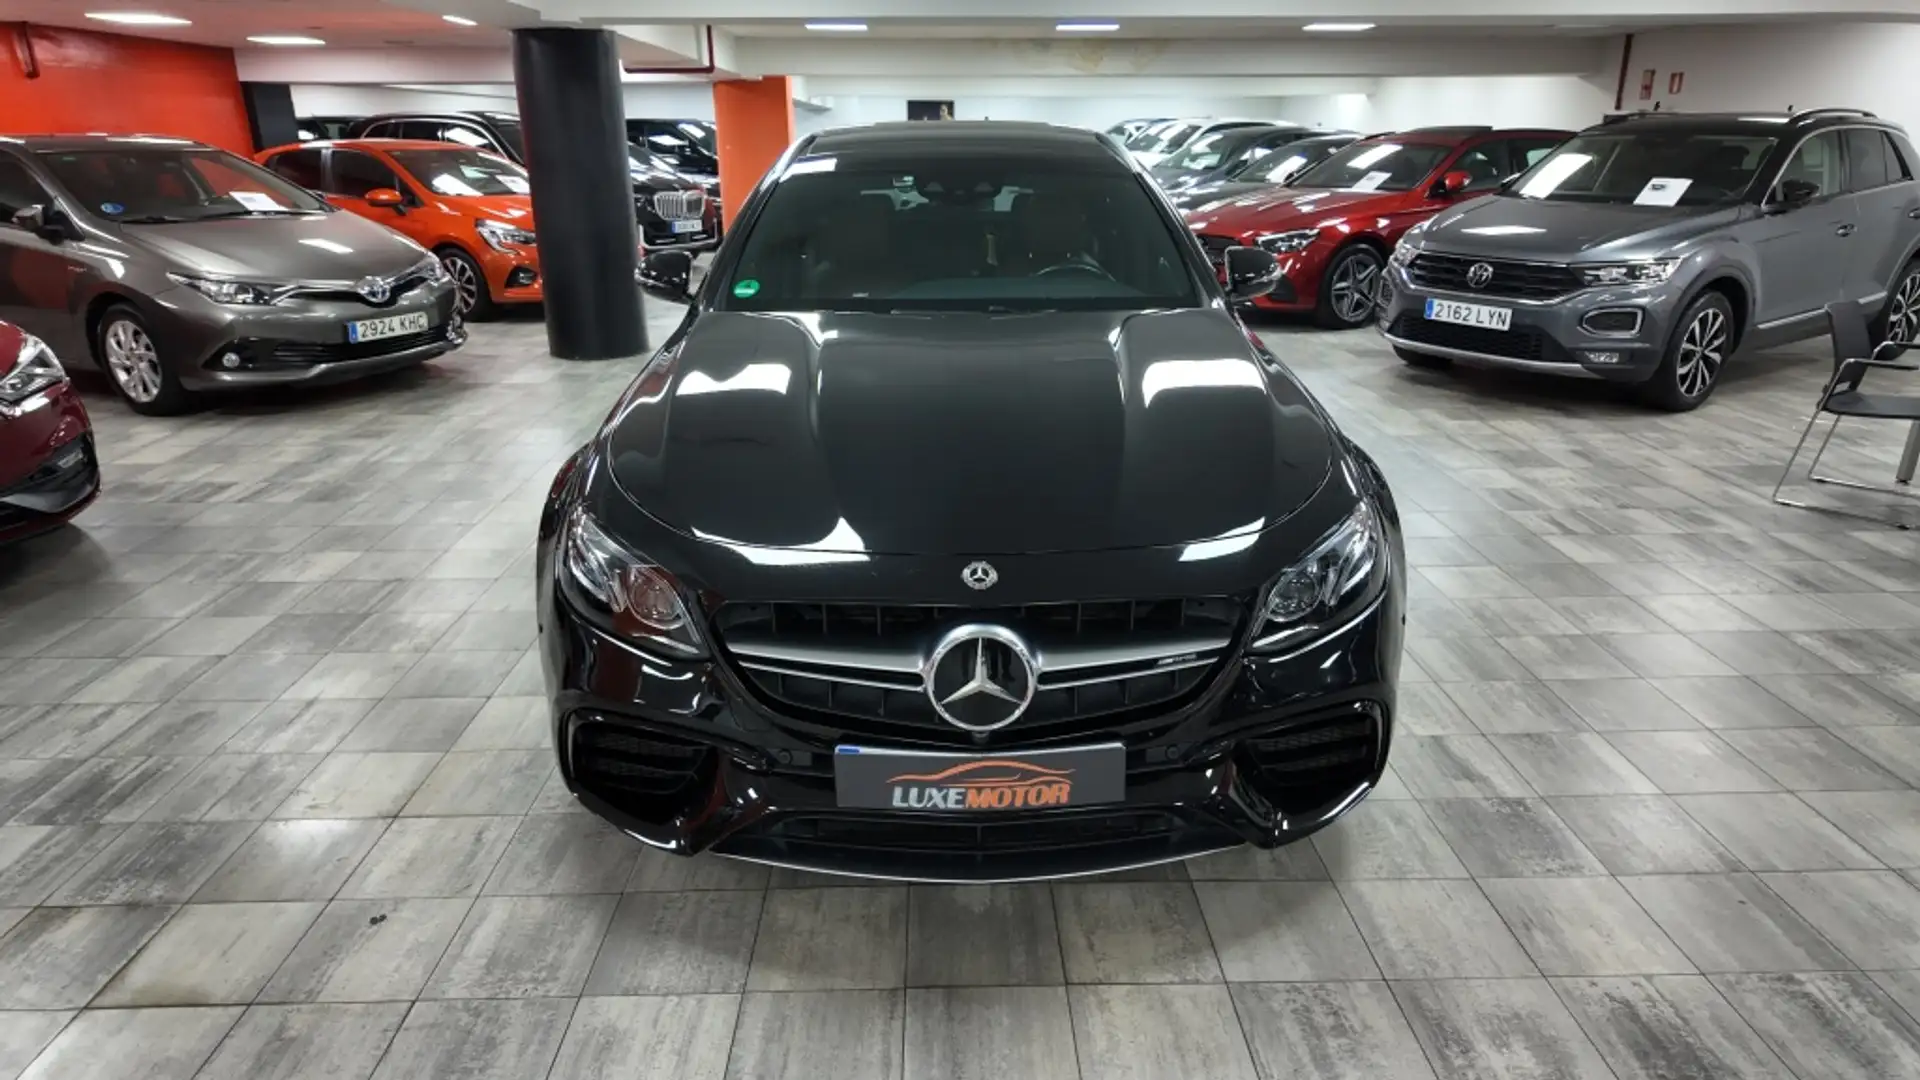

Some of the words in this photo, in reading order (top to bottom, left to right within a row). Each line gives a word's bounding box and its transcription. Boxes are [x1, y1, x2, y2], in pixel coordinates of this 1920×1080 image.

[360, 319, 395, 338] 2924
[399, 314, 424, 331] KHC
[1435, 303, 1472, 321] 2162
[1476, 308, 1507, 327] LYN
[892, 784, 1069, 808] LUXEMOTOR
